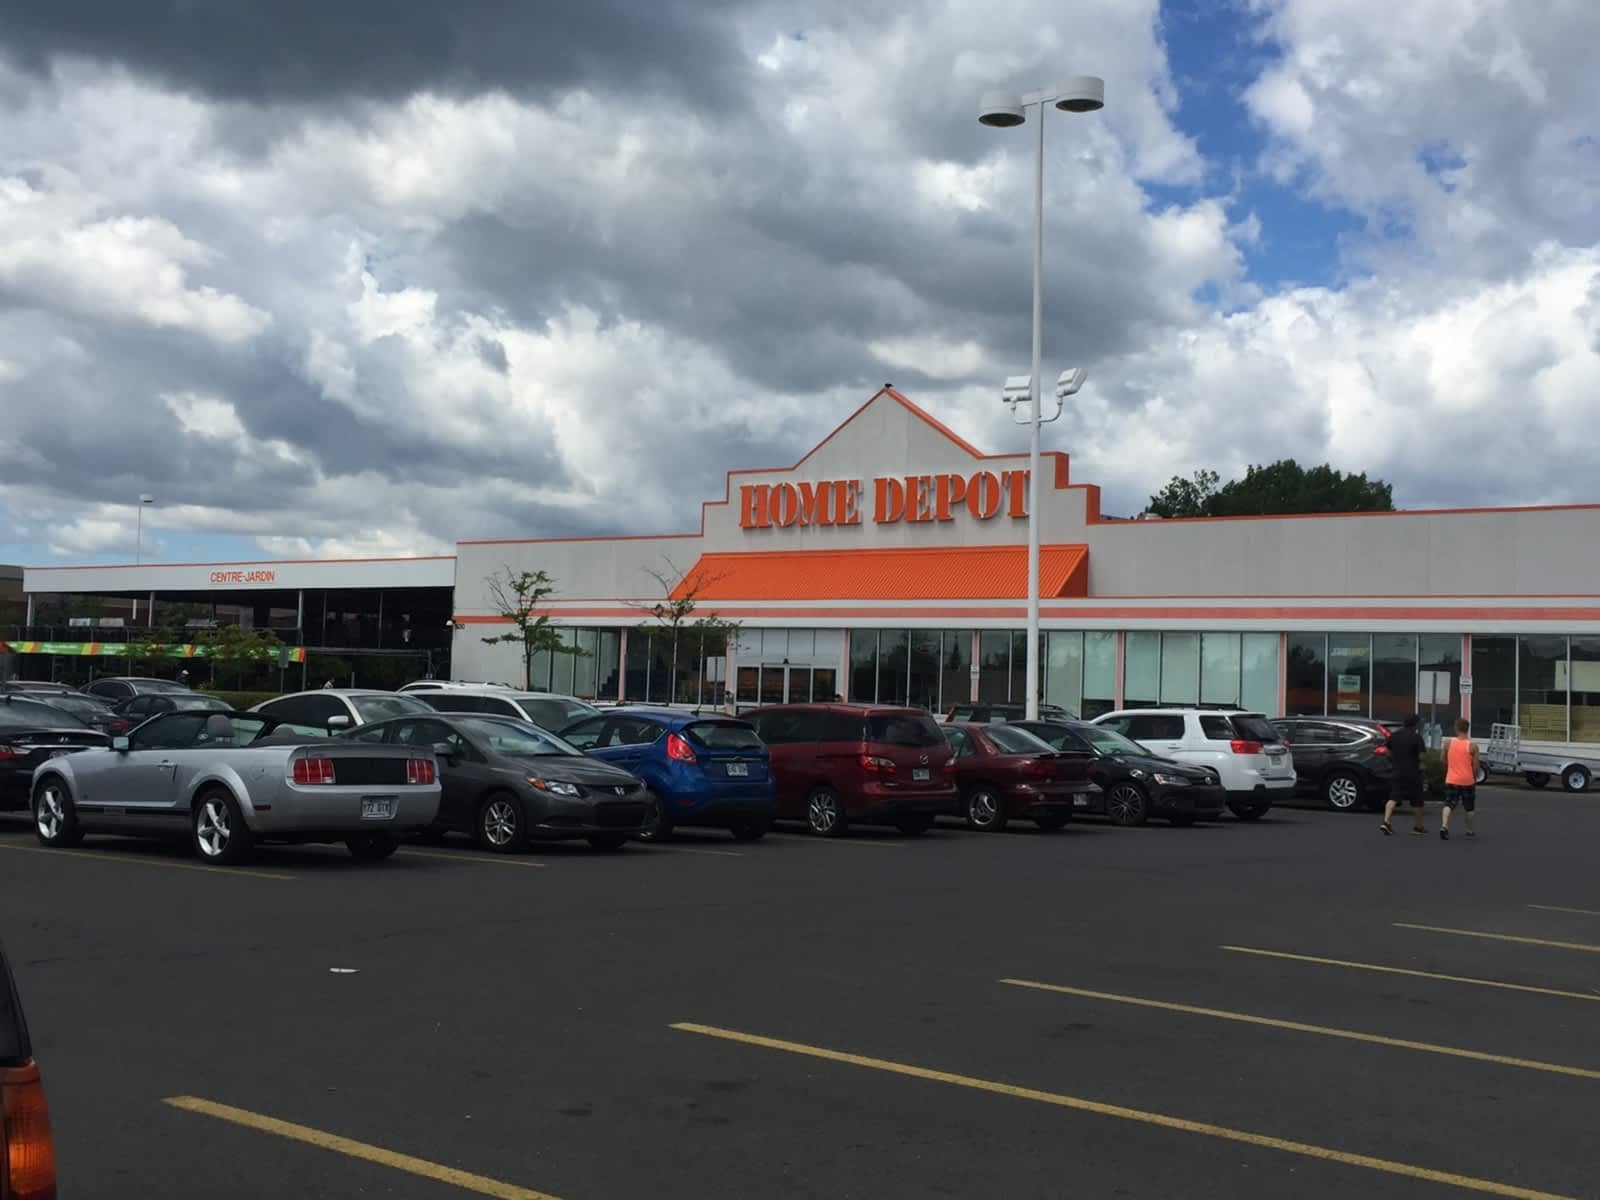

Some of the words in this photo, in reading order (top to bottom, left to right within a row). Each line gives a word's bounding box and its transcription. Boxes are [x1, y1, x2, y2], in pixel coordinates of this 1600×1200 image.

[739, 480, 862, 528] HOME
[873, 470, 1031, 523] DEPOT
[210, 571, 275, 583] CENTRE-JARDIN
